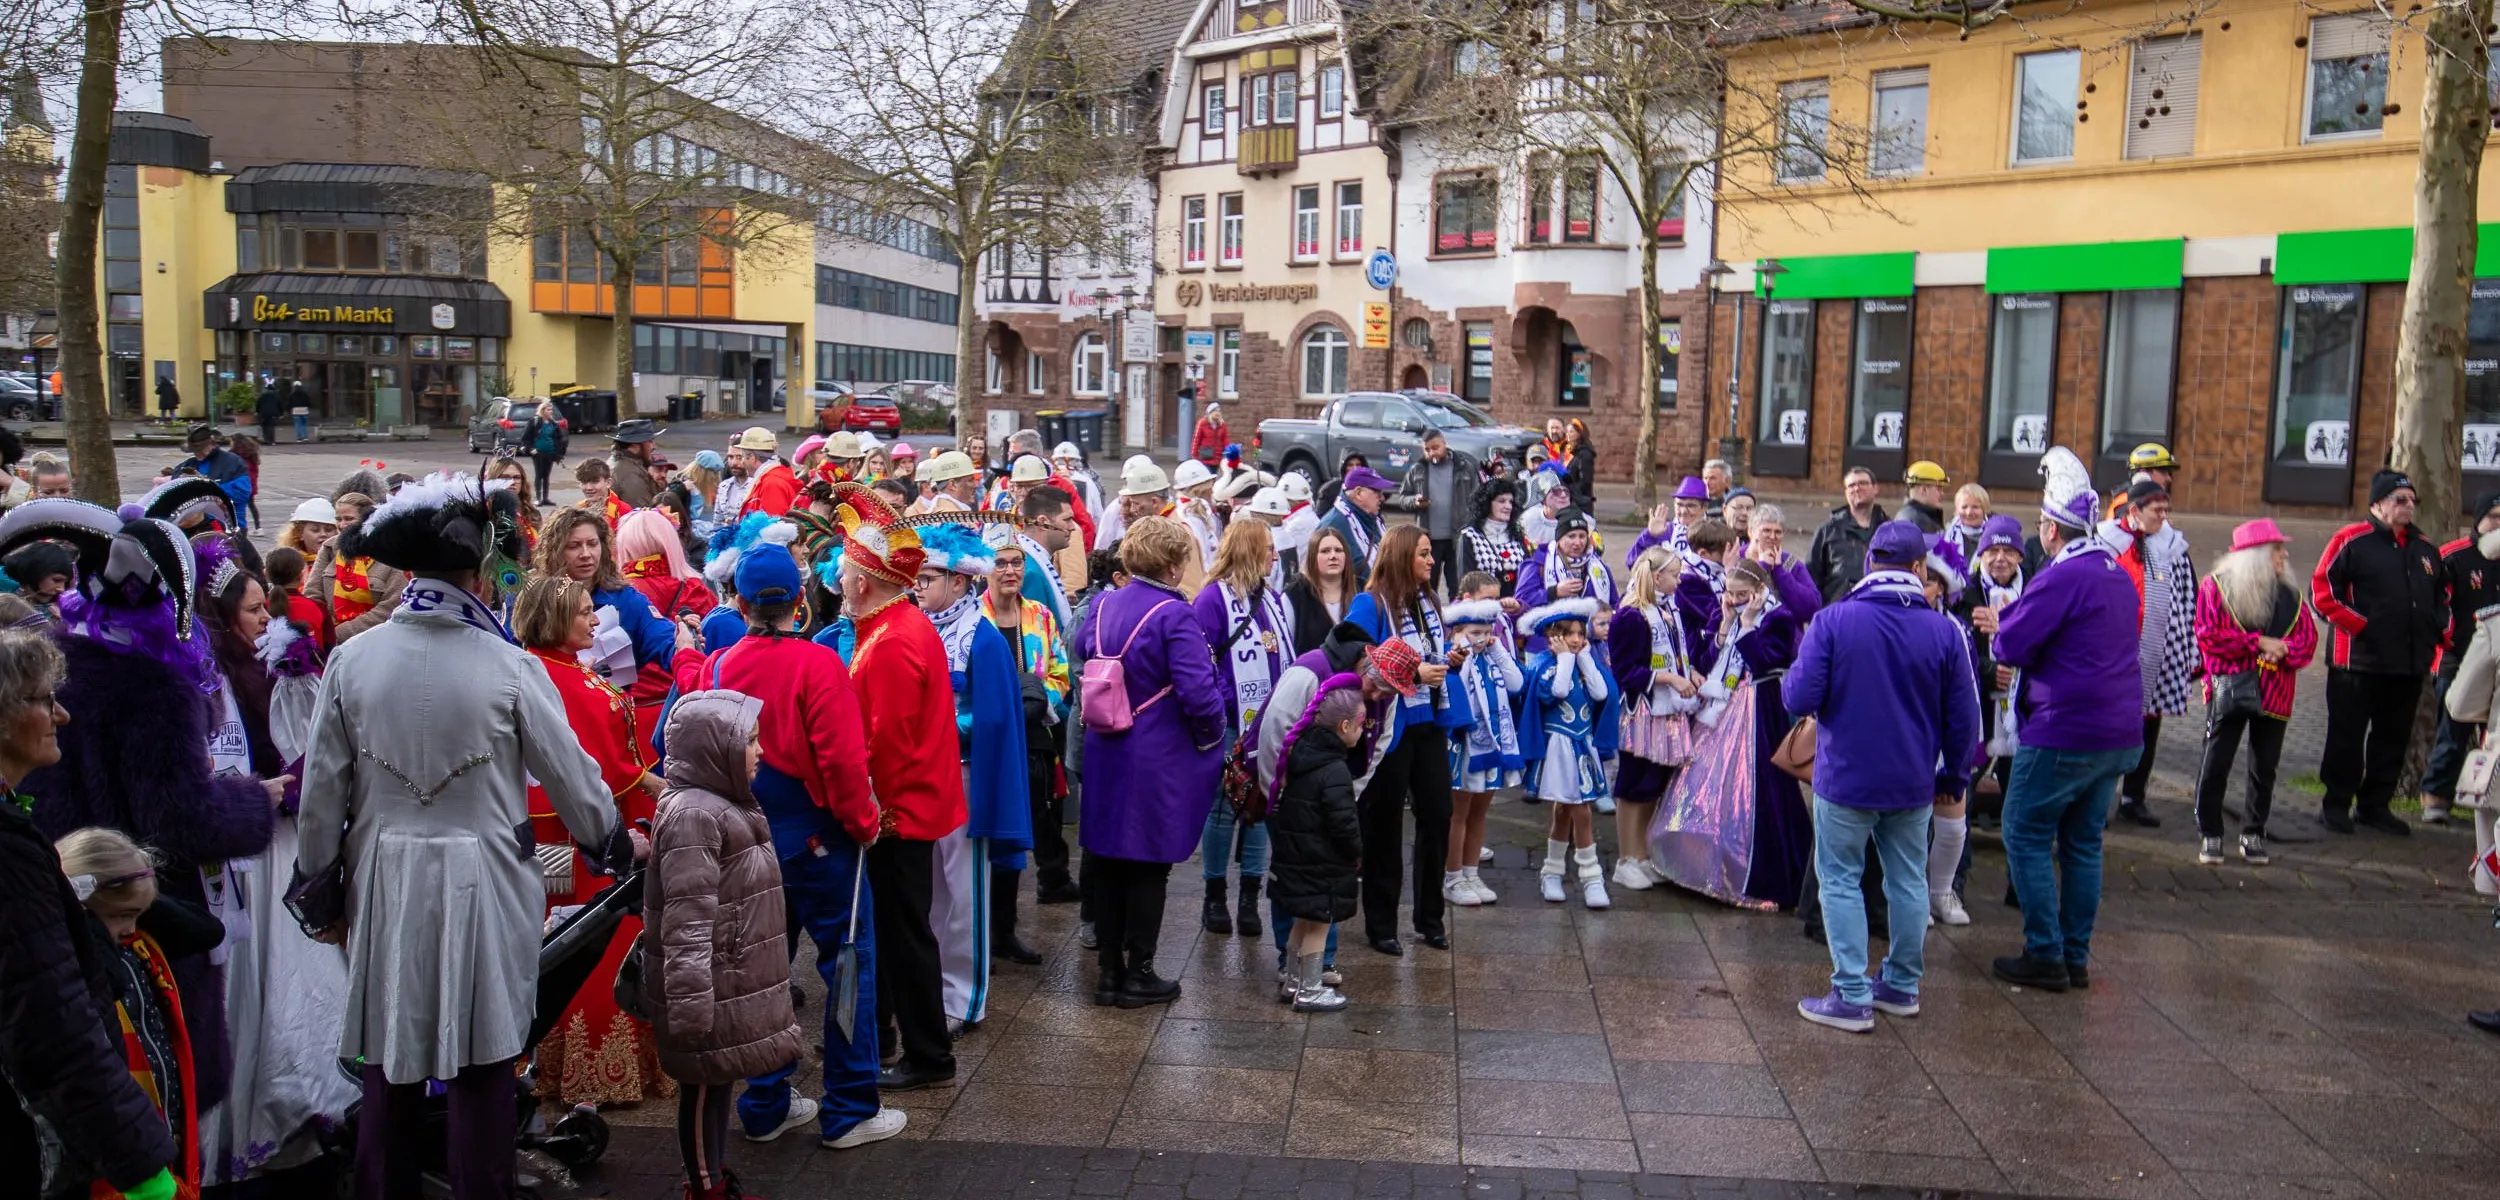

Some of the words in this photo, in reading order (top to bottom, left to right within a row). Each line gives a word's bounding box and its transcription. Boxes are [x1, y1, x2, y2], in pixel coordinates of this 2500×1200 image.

[1209, 282, 1318, 304] Versicherungen
[298, 308, 330, 322] am
[335, 305, 394, 324] Markt
